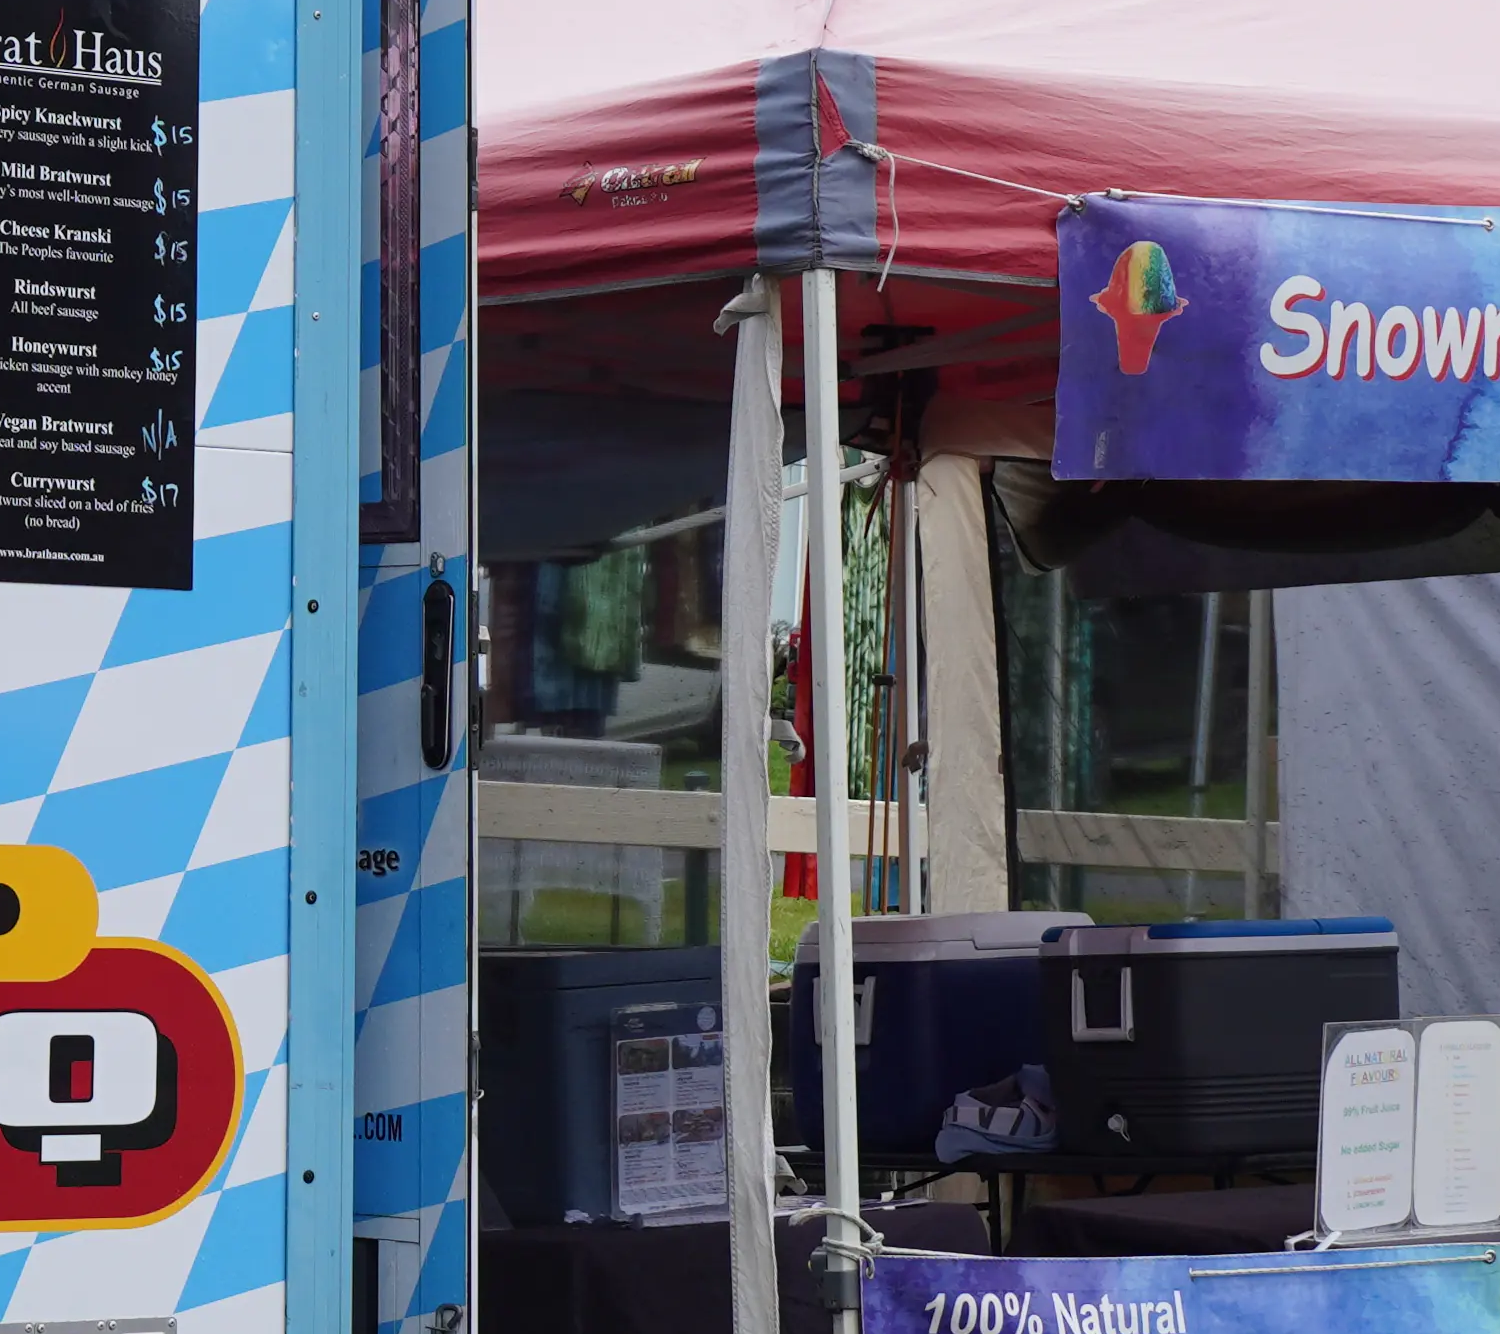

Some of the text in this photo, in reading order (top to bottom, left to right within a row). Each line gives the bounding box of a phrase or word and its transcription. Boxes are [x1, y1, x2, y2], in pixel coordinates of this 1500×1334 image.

[73, 29, 162, 78] Haus
[38, 77, 85, 93] German
[89, 82, 140, 100] Sausage
[35, 107, 122, 131] Knackwurst
[17, 130, 60, 146] sausage
[62, 132, 86, 147] with
[88, 138, 95, 148] a
[97, 134, 128, 153] slight
[130, 139, 153, 153] kick
[151, 115, 193, 157] $15
[1, 161, 112, 187] Mild Bratwurst
[18, 188, 44, 201] most
[47, 189, 110, 207] well-known
[113, 196, 154, 212] sausage
[154, 177, 191, 216] $15
[0, 219, 112, 244] Cheese Kranski
[21, 243, 64, 260] Peoples
[66, 247, 114, 264] favourite
[154, 230, 189, 266] $15
[14, 278, 96, 300] Rindswurst
[10, 301, 99, 322] All beef sausage
[153, 293, 187, 328] $15
[11, 336, 98, 358] Honeywurst
[150, 346, 183, 372] $15
[30, 362, 74, 377] sausage
[75, 363, 100, 378] with
[101, 366, 144, 384] smokey
[146, 368, 178, 385] honey
[36, 381, 72, 395] accent
[41, 415, 114, 436] Bratwurst
[141, 408, 178, 461] N/A
[17, 437, 37, 451] and
[39, 441, 60, 455] soy
[61, 440, 92, 455] based
[94, 443, 136, 458] sausage
[10, 471, 96, 493] Currywurst
[141, 476, 178, 508] $17
[34, 495, 66, 510] sliced
[68, 499, 83, 511] on
[84, 501, 92, 511] a
[94, 498, 114, 512] bed
[115, 499, 131, 513] of
[130, 501, 154, 515] fries
[24, 514, 80, 533] (no bread)
[0, 547, 105, 562] www.brathaus.com.au
[1353, 1142, 1377, 1154] added
[1379, 1141, 1400, 1154] Sugar
